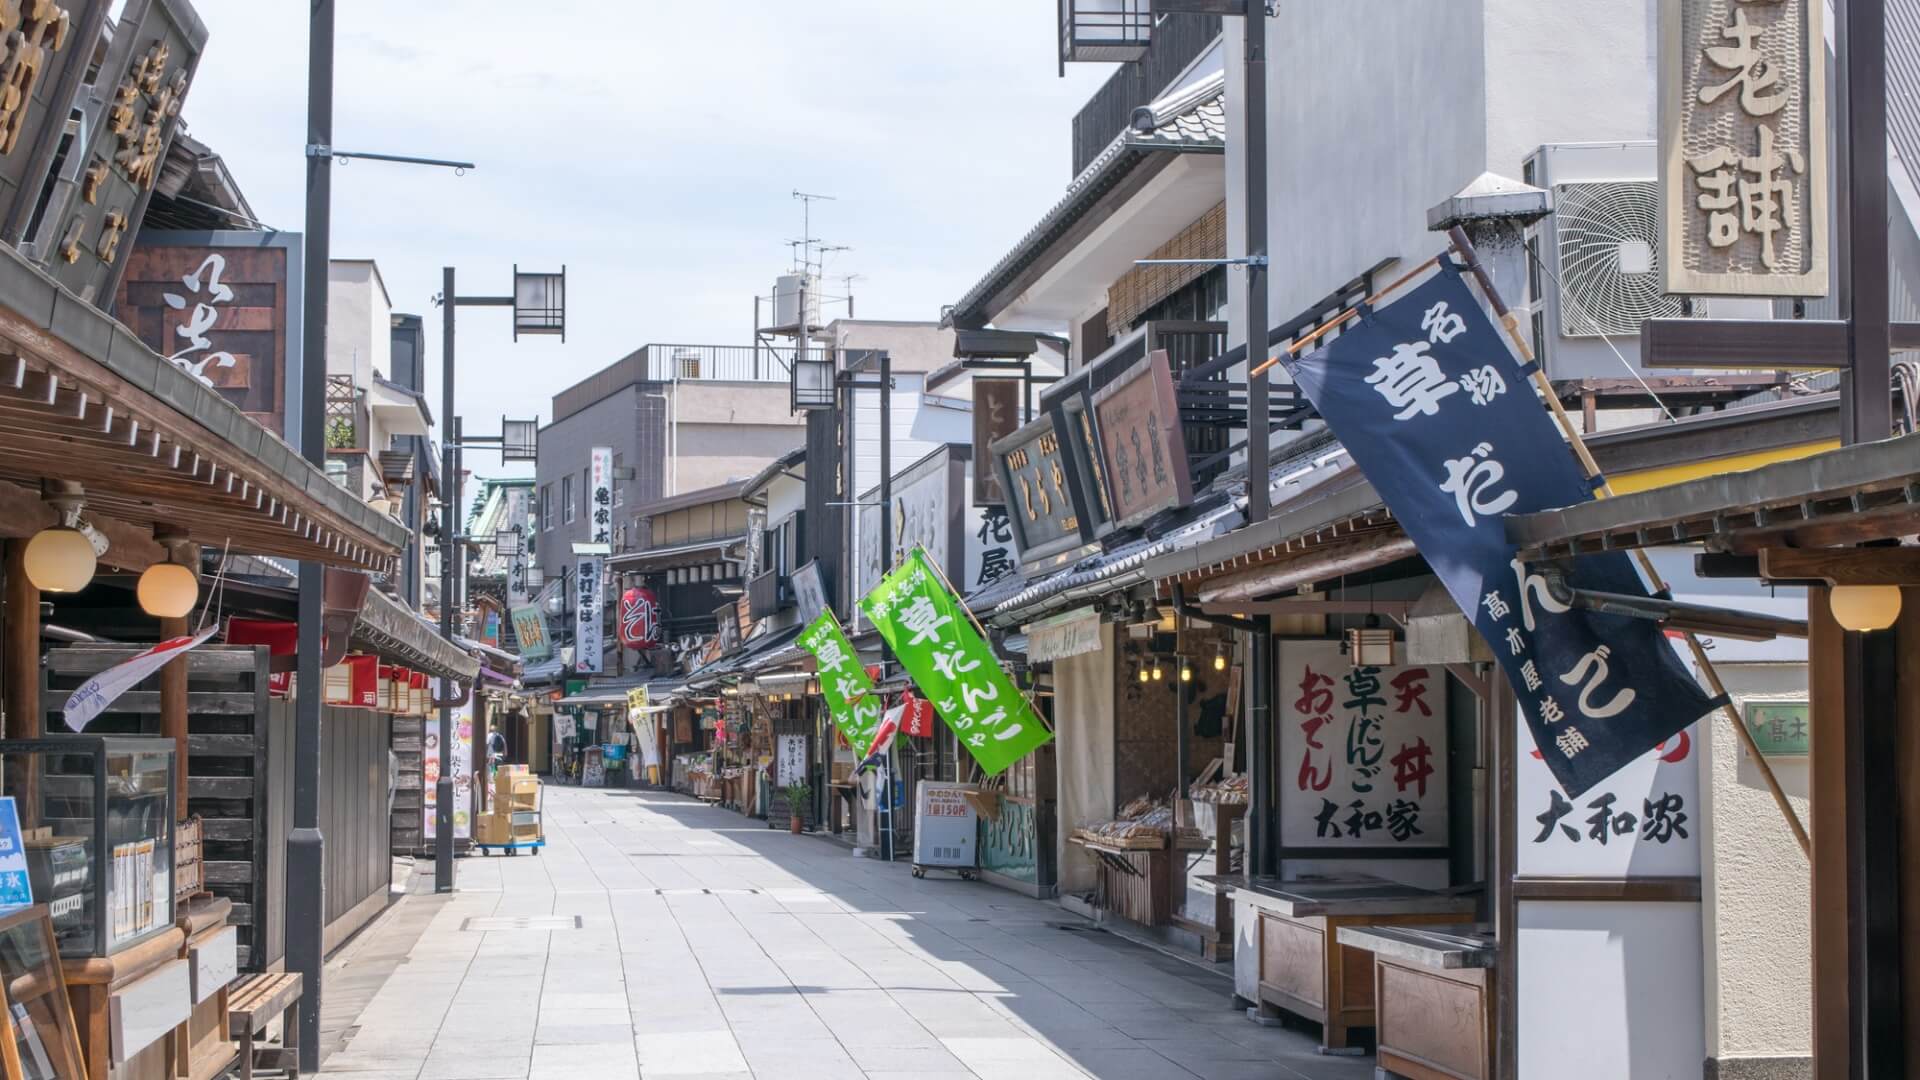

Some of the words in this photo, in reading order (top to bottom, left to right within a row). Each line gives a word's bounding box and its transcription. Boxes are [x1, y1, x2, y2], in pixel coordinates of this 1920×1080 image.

[1687, 0, 1804, 267] 老舗
[1421, 300, 1507, 407] 名物
[579, 563, 594, 623] 手打そば
[1364, 341, 1636, 718] 草だんご
[897, 597, 1023, 740] 草だんご
[939, 695, 987, 748] とらや
[1294, 664, 1336, 792] おでん
[1342, 666, 1387, 793] 草だんご
[1389, 668, 1435, 799] 天丼
[1314, 797, 1424, 842] 大和家
[1533, 789, 1690, 845] 大和家
